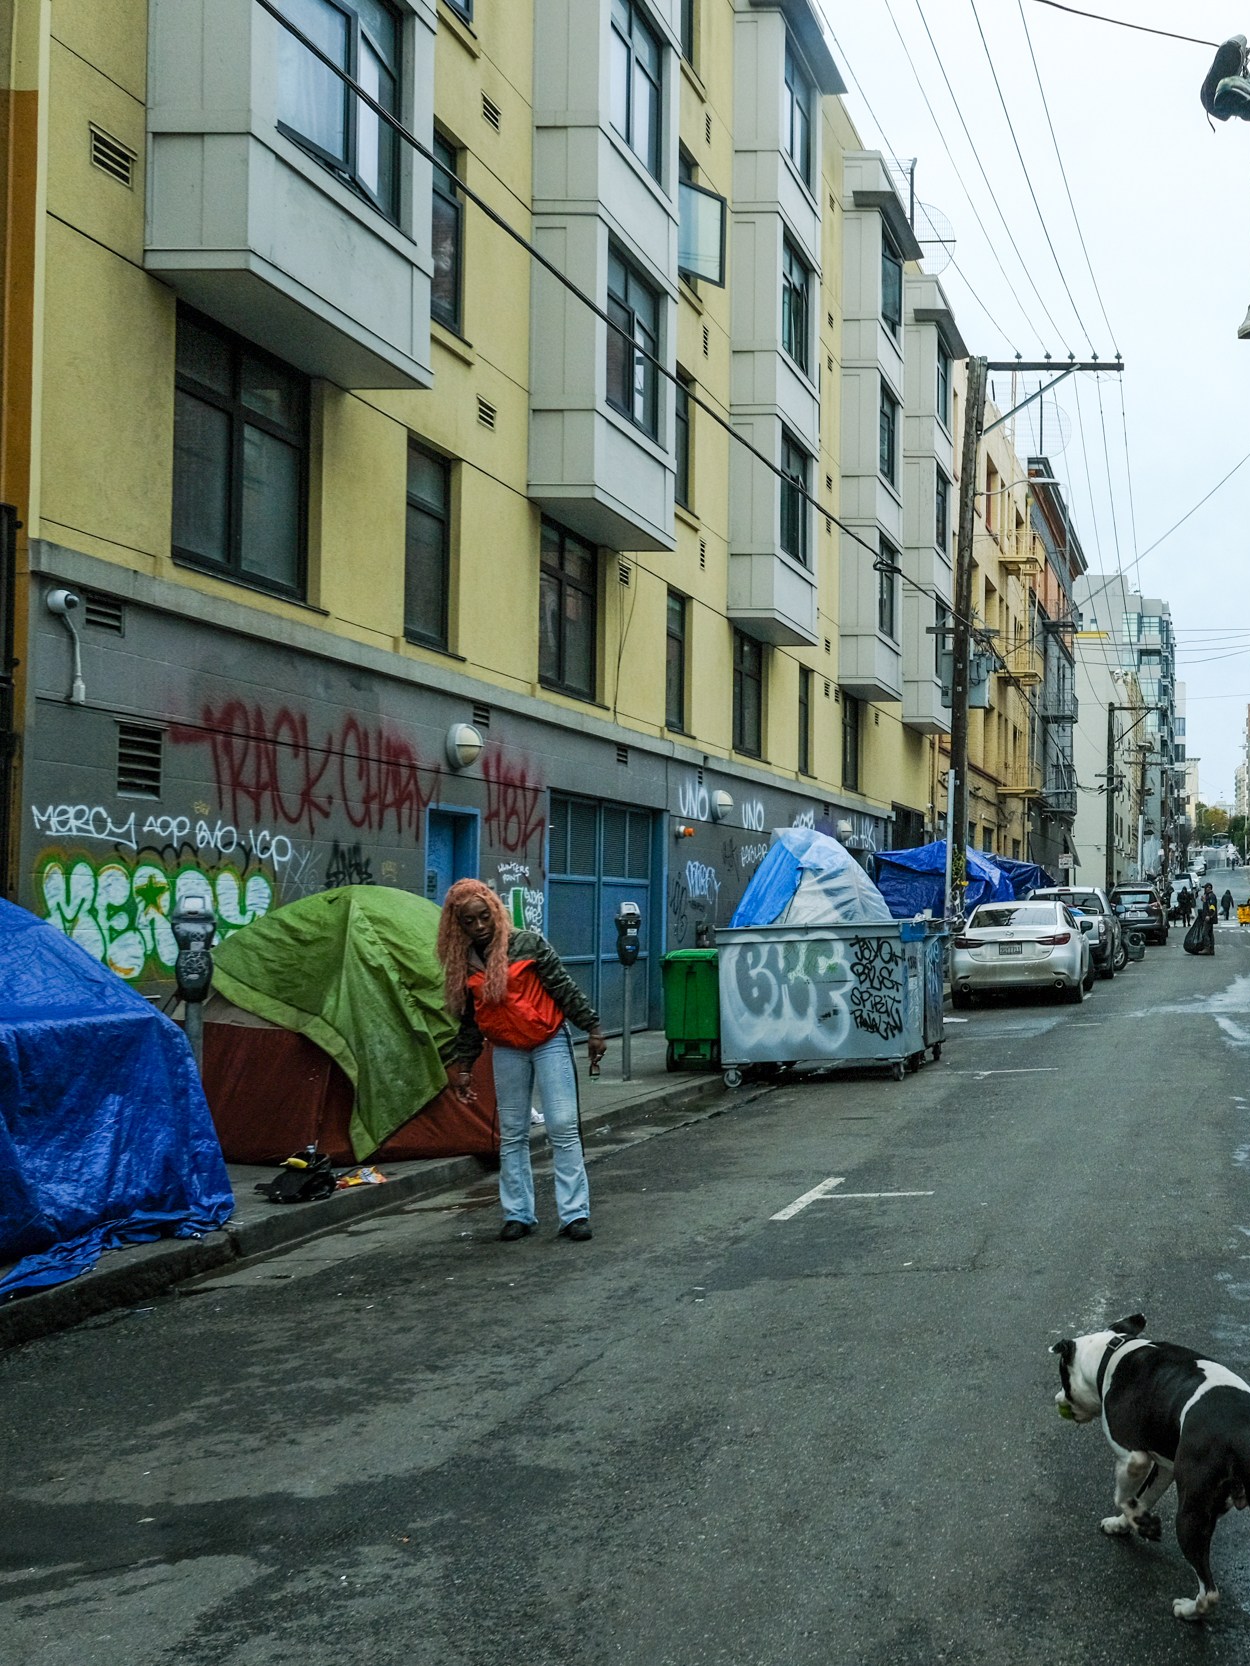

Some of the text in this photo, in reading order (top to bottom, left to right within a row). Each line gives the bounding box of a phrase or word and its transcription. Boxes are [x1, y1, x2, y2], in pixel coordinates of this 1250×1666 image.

[31, 804, 138, 851] MERCY
[679, 779, 709, 821] UNO
[741, 799, 765, 832] UNO
